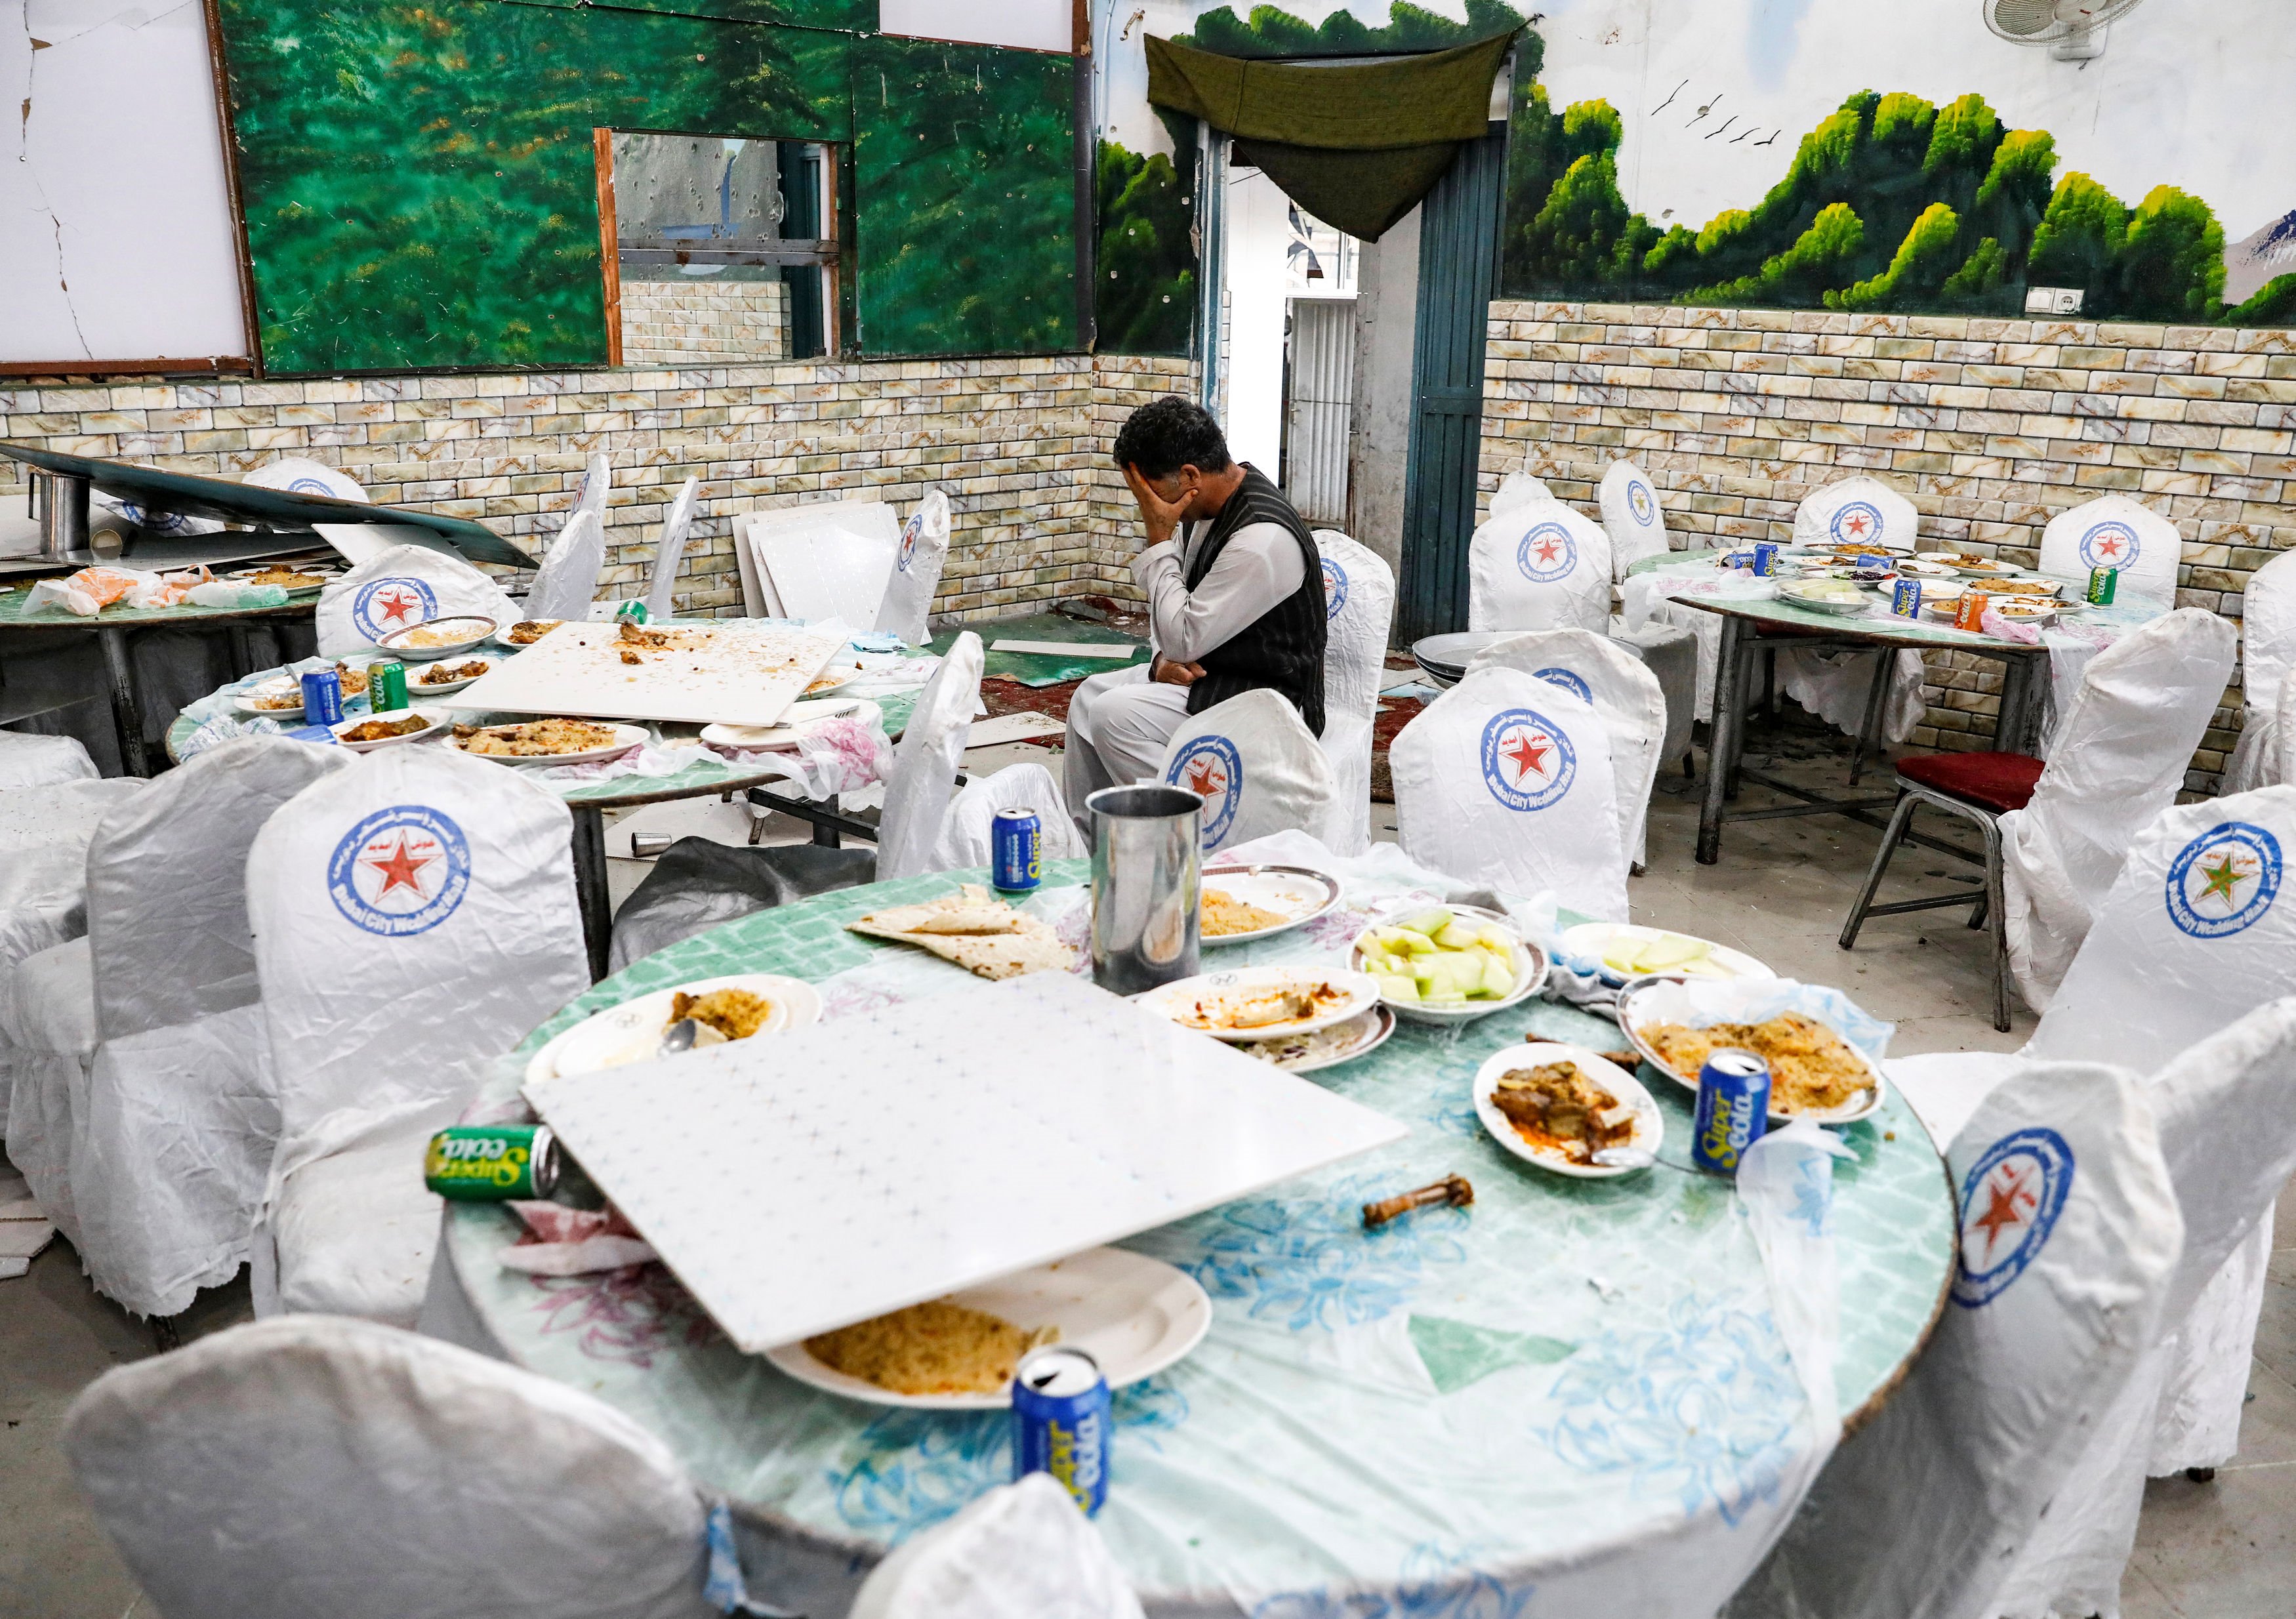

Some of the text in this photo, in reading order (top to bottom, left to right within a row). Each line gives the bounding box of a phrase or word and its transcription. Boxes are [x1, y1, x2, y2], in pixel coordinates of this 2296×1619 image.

[1519, 558, 1575, 581] Dubai City Wedding Hall
[1765, 550, 1774, 577] Super
[1908, 588, 1917, 610] cola
[2089, 574, 2099, 602] Super
[2097, 576, 2106, 595] cola
[1897, 586, 1910, 617] Super
[1960, 602, 1971, 623] cola
[355, 611, 374, 635] Dubai
[373, 675, 384, 705] cola
[1488, 761, 1574, 810] Dubai City Wedding Hall
[333, 875, 466, 934] Dubai City Wedding Hall
[2168, 880, 2270, 934] Dubai City Wedding Hall
[1702, 1088, 1737, 1168] Super
[1728, 1092, 1753, 1149] cola
[442, 1138, 506, 1160] cola
[1073, 1412, 1101, 1488] cola
